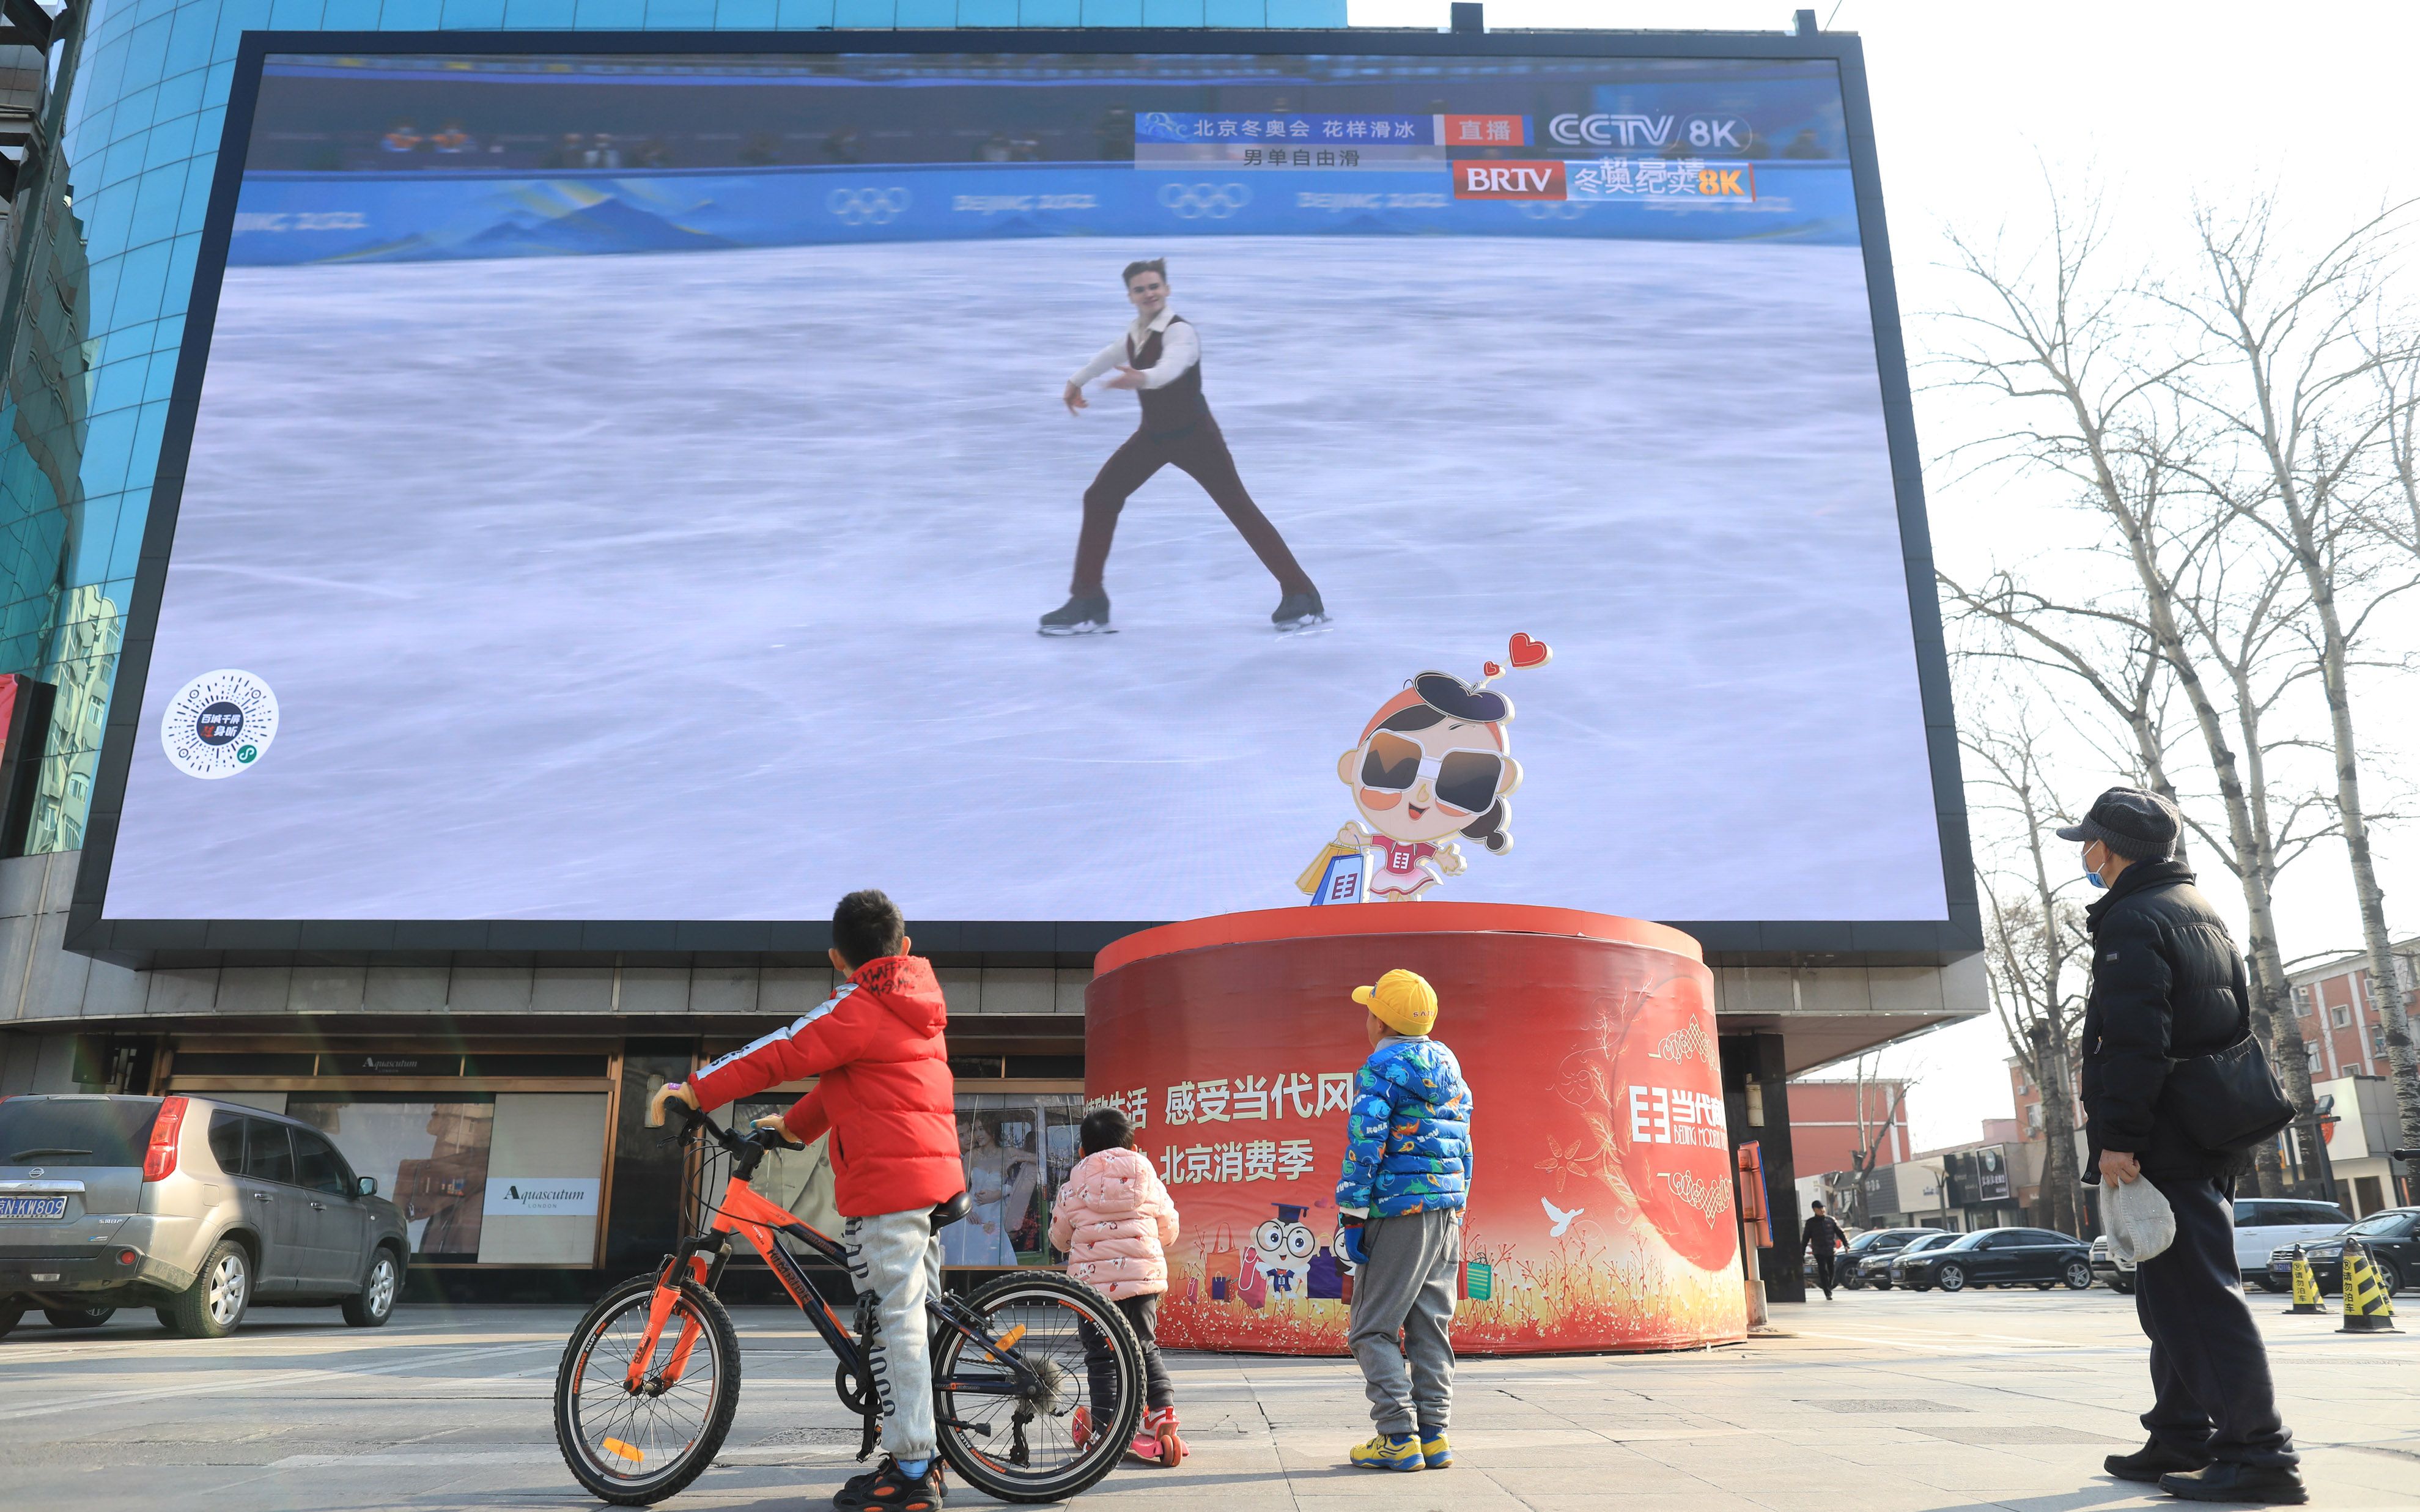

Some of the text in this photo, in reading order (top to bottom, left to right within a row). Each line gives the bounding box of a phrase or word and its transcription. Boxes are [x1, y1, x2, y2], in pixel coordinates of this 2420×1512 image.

[1193, 119, 1415, 138] 北京冬奥会 花样滑冰
[1459, 120, 1511, 141] 直播
[1549, 114, 1741, 147] CCTV 8K
[1244, 149, 1359, 167] 男单自由滑
[1466, 167, 1553, 193] BRTV
[363, 1057, 418, 1070] Aquascutum
[1160, 1139, 1314, 1185] 北京消费季
[503, 1186, 584, 1204] Aquascutum
[2295, 1272, 2307, 1302] 请勿泊车
[2343, 1272, 2355, 1313] 请勿泊车
[641, 1322, 654, 1348] JUNIOR
[1093, 1321, 1107, 1337] ALLOY
[585, 1334, 597, 1352] ALLOY
[957, 1433, 972, 1448] ALLOY
